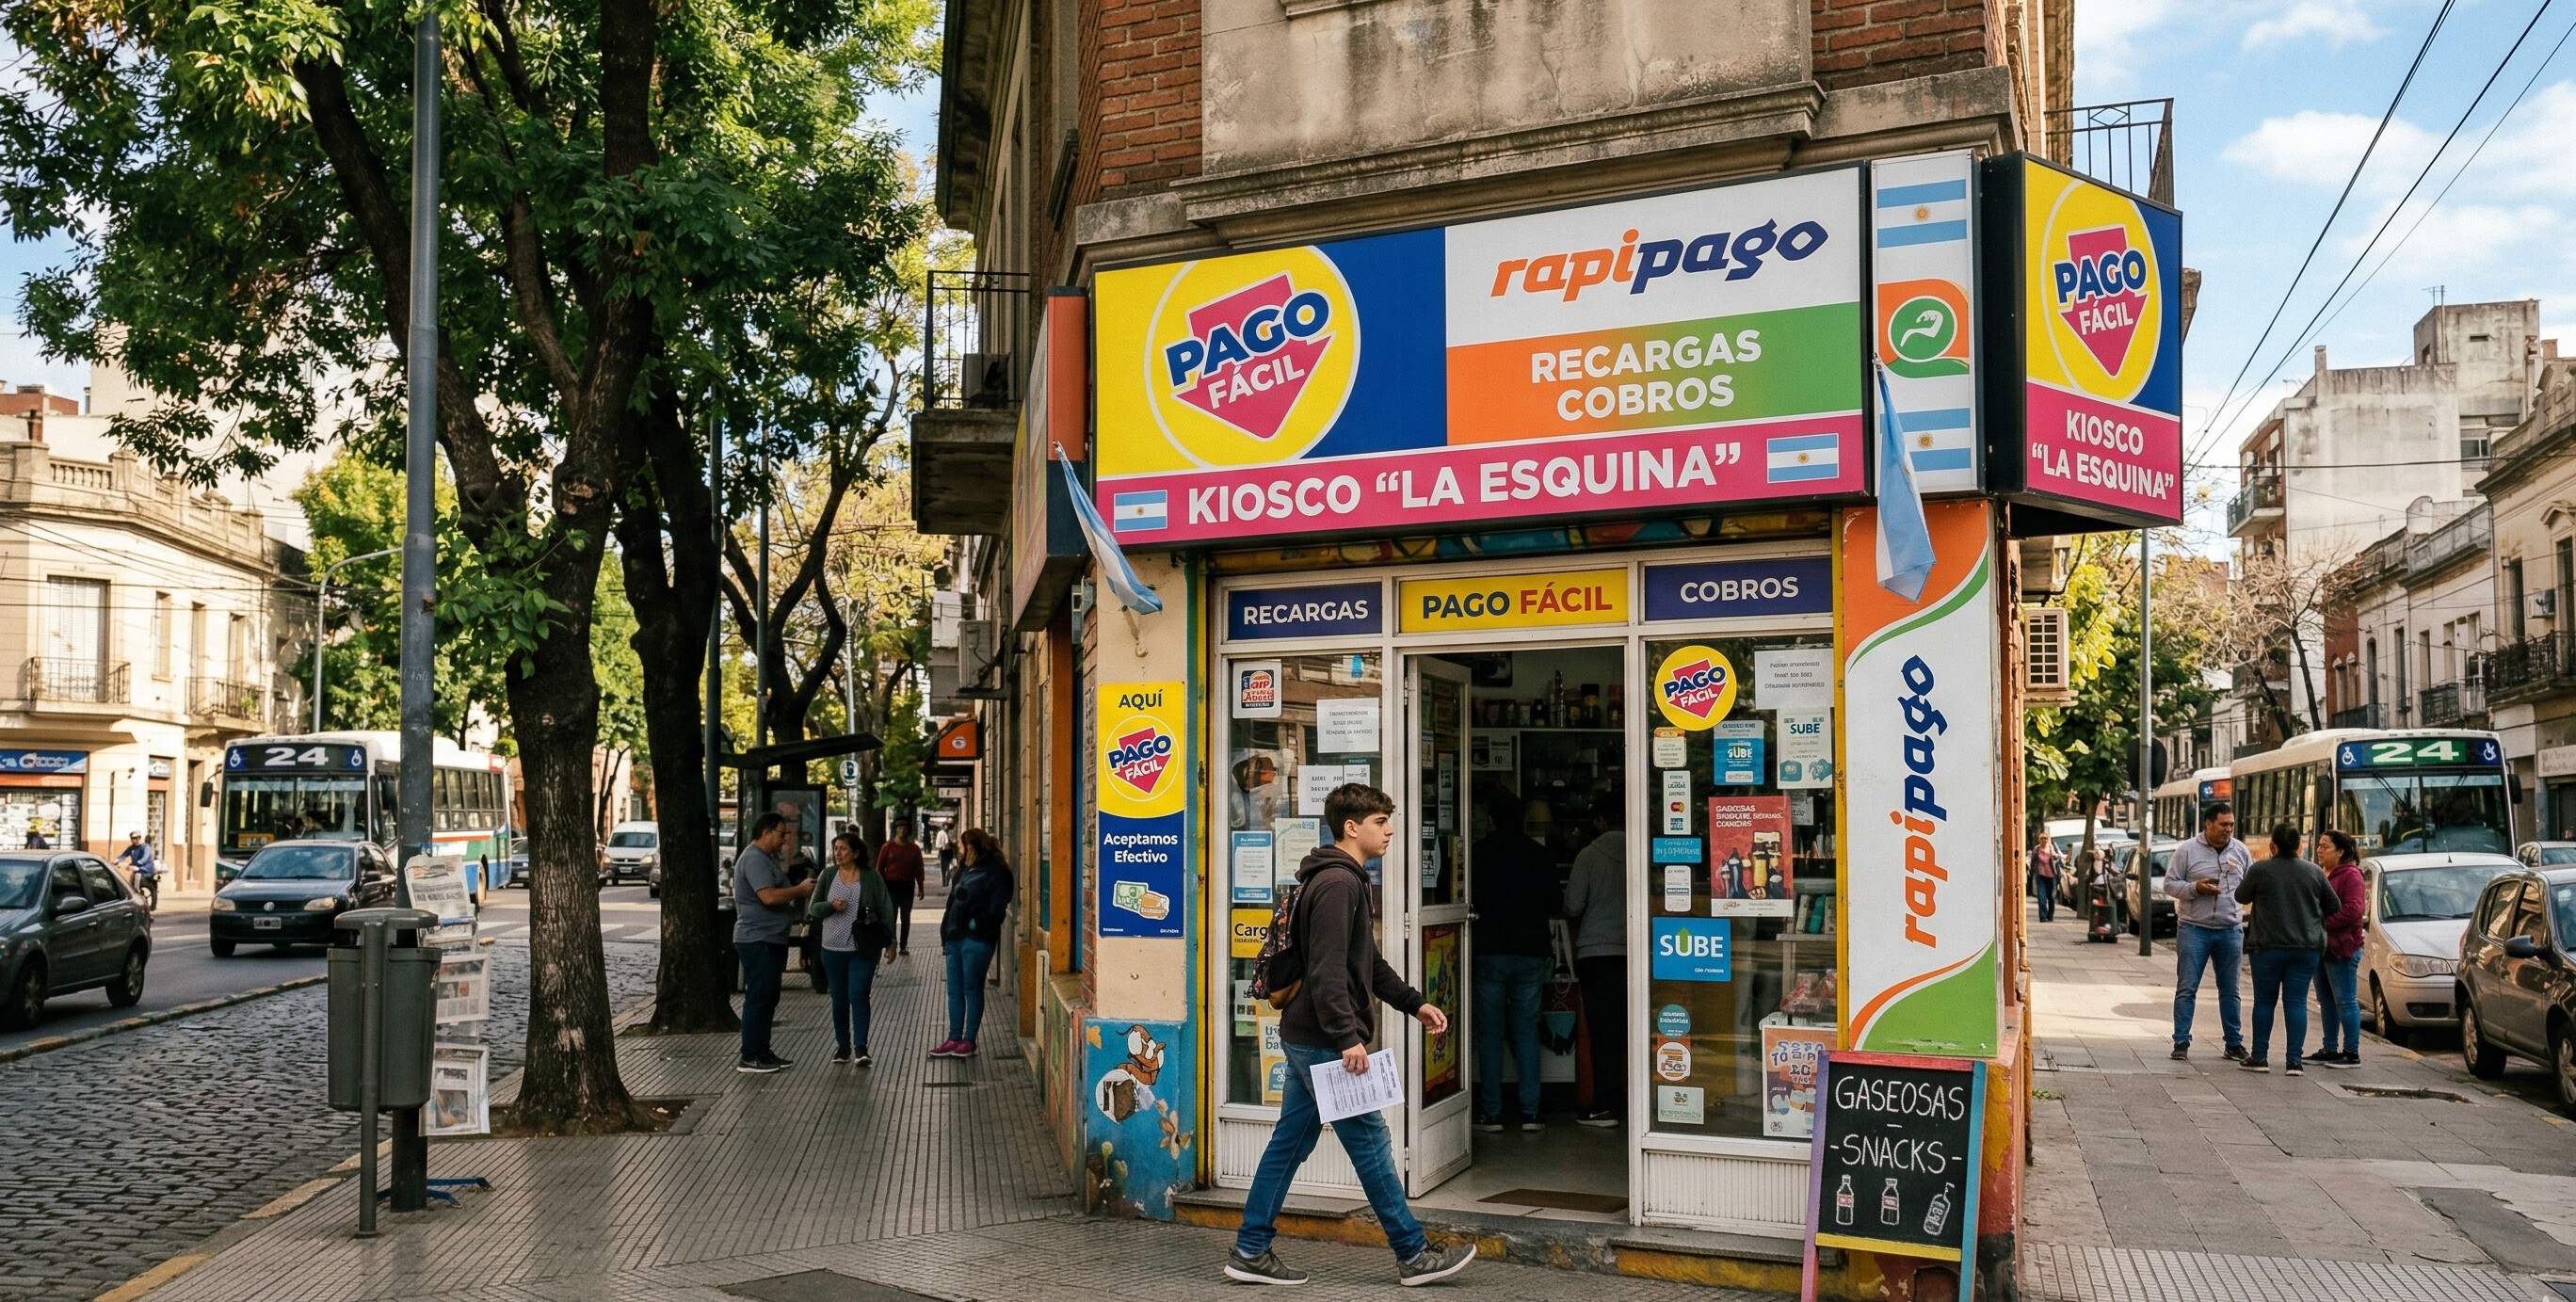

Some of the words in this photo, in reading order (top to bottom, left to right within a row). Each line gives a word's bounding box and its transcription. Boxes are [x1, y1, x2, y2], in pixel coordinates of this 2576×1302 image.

[1490, 217, 1828, 303] rapipago
[2053, 249, 2147, 305] PAGO
[2078, 299, 2134, 338] FÁCIL
[1165, 291, 1330, 387] PAGO
[1531, 329, 1762, 386] RECARGAS
[1208, 353, 1306, 410] FÁCIL
[1556, 373, 1735, 423] COBROS
[2067, 409, 2144, 457] KIOSCO
[1188, 474, 1361, 526] KIOSCO
[1376, 465, 1466, 510] “LA
[1479, 442, 1743, 504] ESQUINA”
[2032, 442, 2072, 482] “LA
[2076, 450, 2176, 502] ESQUINA”
[1422, 589, 1511, 620] PAGO
[1520, 581, 1613, 615] FÁCIL
[1680, 576, 1799, 604] COBROS
[1243, 599, 1369, 625] RECARGAS
[1119, 689, 1163, 711] AQUÍ
[1663, 666, 1727, 699] PAGO
[1790, 723, 1821, 734] SUBE
[265, 747, 329, 766] 24
[1108, 734, 1171, 769] PAGO
[2370, 741, 2459, 764] 24
[1891, 654, 1949, 949] rapipago
[1103, 833, 1179, 848] Aceptamos
[1114, 850, 1168, 863] Efectivo
[1660, 933, 1724, 957] SUBE
[1836, 1076, 1965, 1120] GASEOSAS
